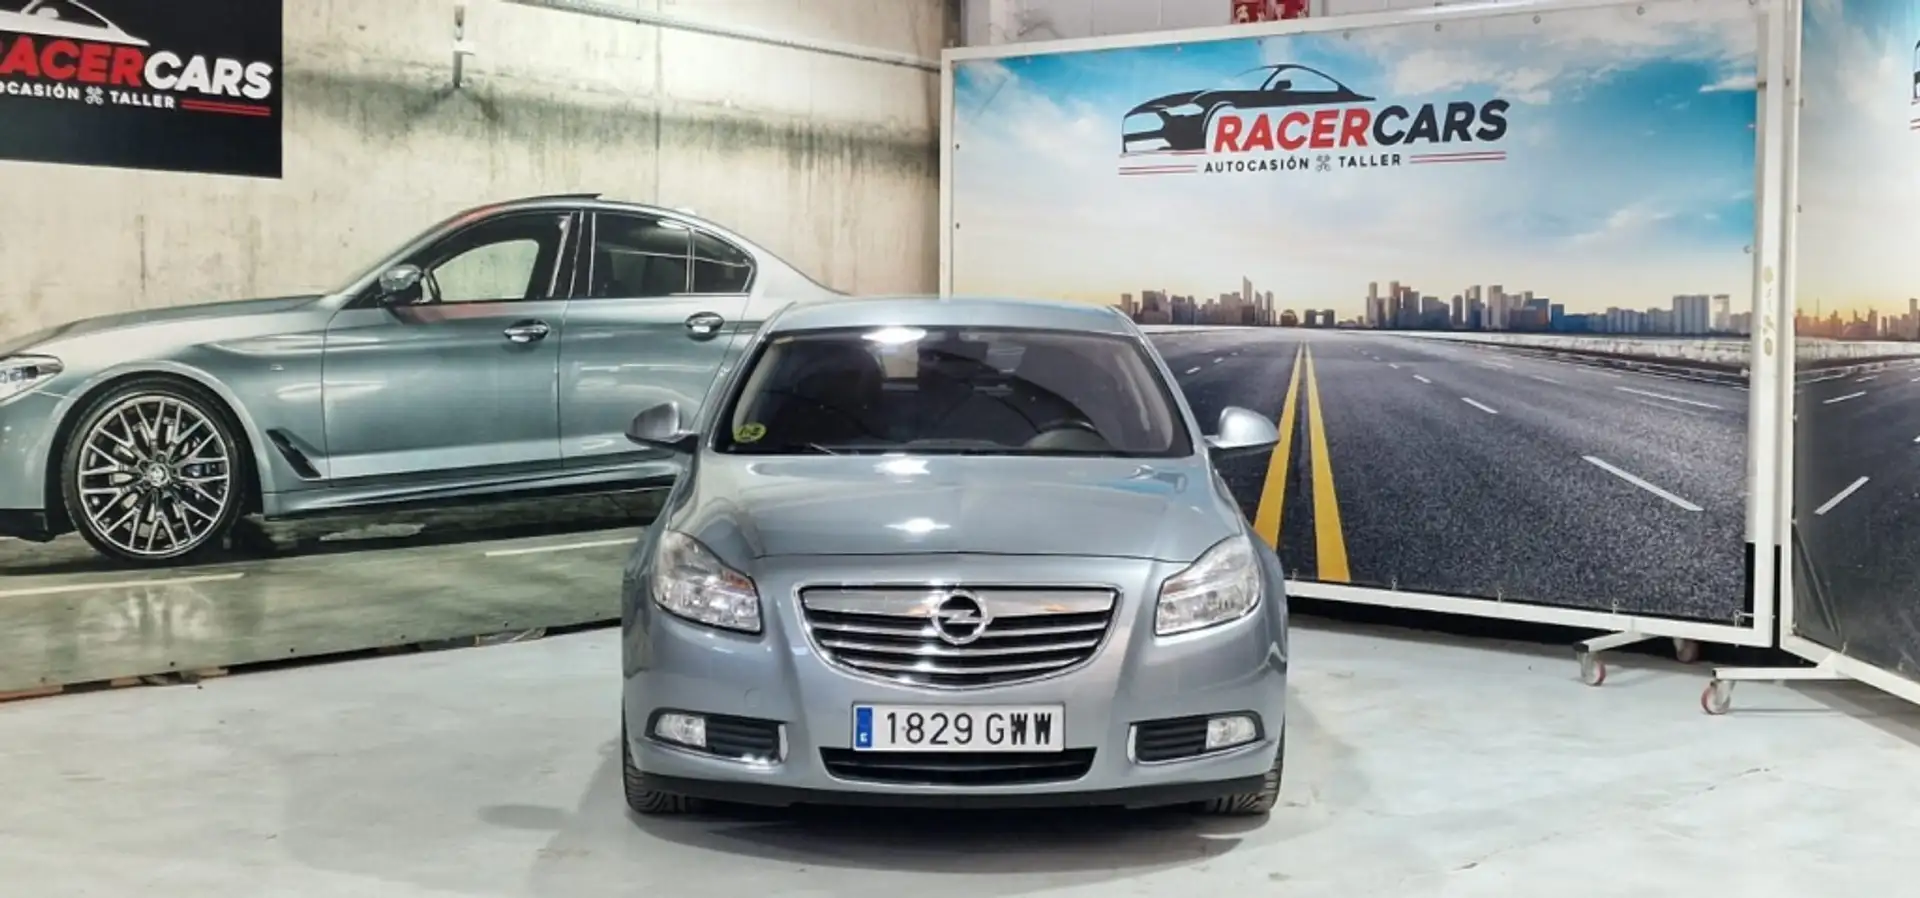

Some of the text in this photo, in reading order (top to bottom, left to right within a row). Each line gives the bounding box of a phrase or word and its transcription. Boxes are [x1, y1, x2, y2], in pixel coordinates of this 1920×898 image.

[0, 34, 273, 99] ACERCARS
[109, 90, 175, 109] TALLER
[1213, 99, 1510, 153] RACERCARS
[1204, 154, 1402, 173] AUTOCASIÓN TALLER
[887, 712, 1052, 745] 1829 GWW
